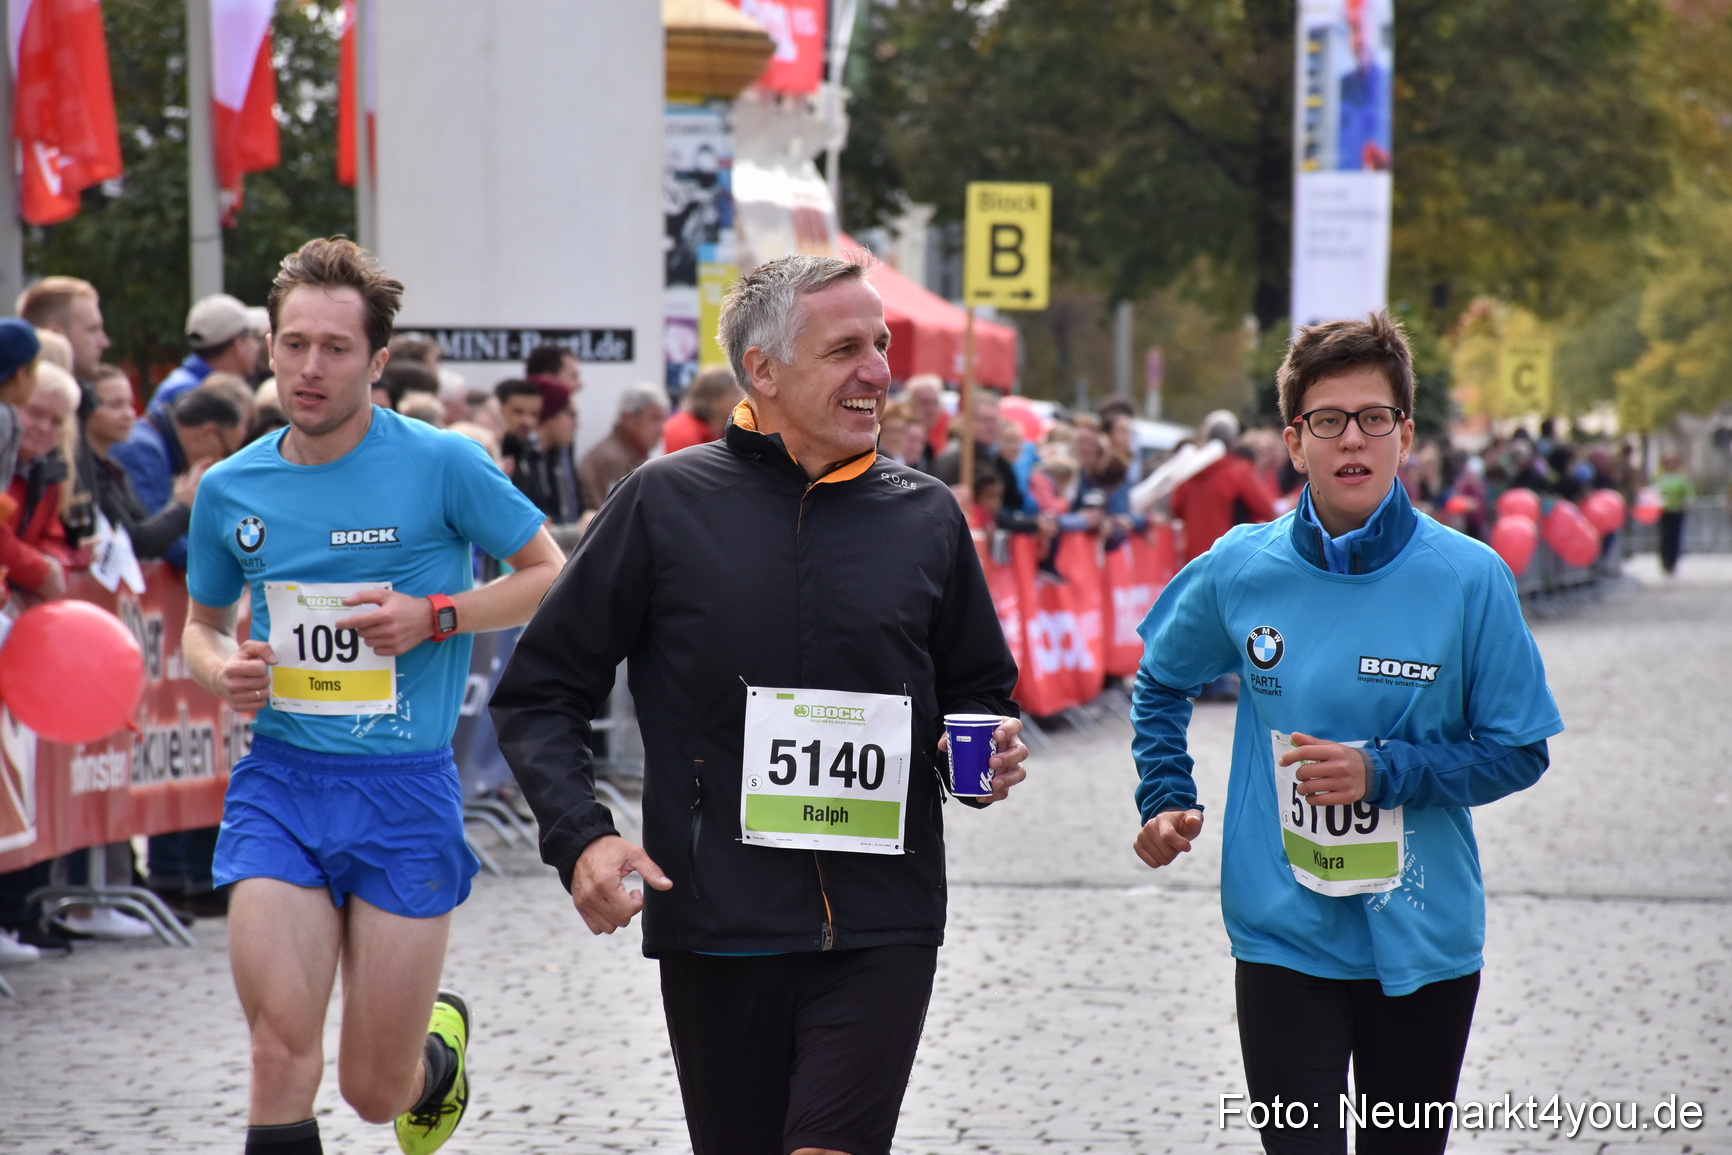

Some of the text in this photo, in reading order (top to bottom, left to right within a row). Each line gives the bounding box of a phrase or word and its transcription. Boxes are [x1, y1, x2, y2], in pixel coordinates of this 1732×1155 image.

[990, 223, 1025, 277] B
[881, 472, 917, 488] GORE
[330, 527, 399, 546] BOCK
[293, 623, 359, 663] 109
[1249, 627, 1282, 643] BMW
[1359, 656, 1441, 682] BOCK
[308, 677, 342, 691] Toms
[1251, 673, 1282, 689] PARTL
[1357, 675, 1384, 684] inspired
[1385, 678, 1394, 686] by
[1395, 680, 1414, 688] smart
[811, 705, 865, 721] BOCK
[768, 739, 886, 791] 5140
[752, 778, 757, 787] S
[803, 805, 849, 826] Ralph
[1291, 781, 1380, 837] 5109
[1313, 849, 1345, 870] Klara
[1404, 853, 1416, 871] 2017
